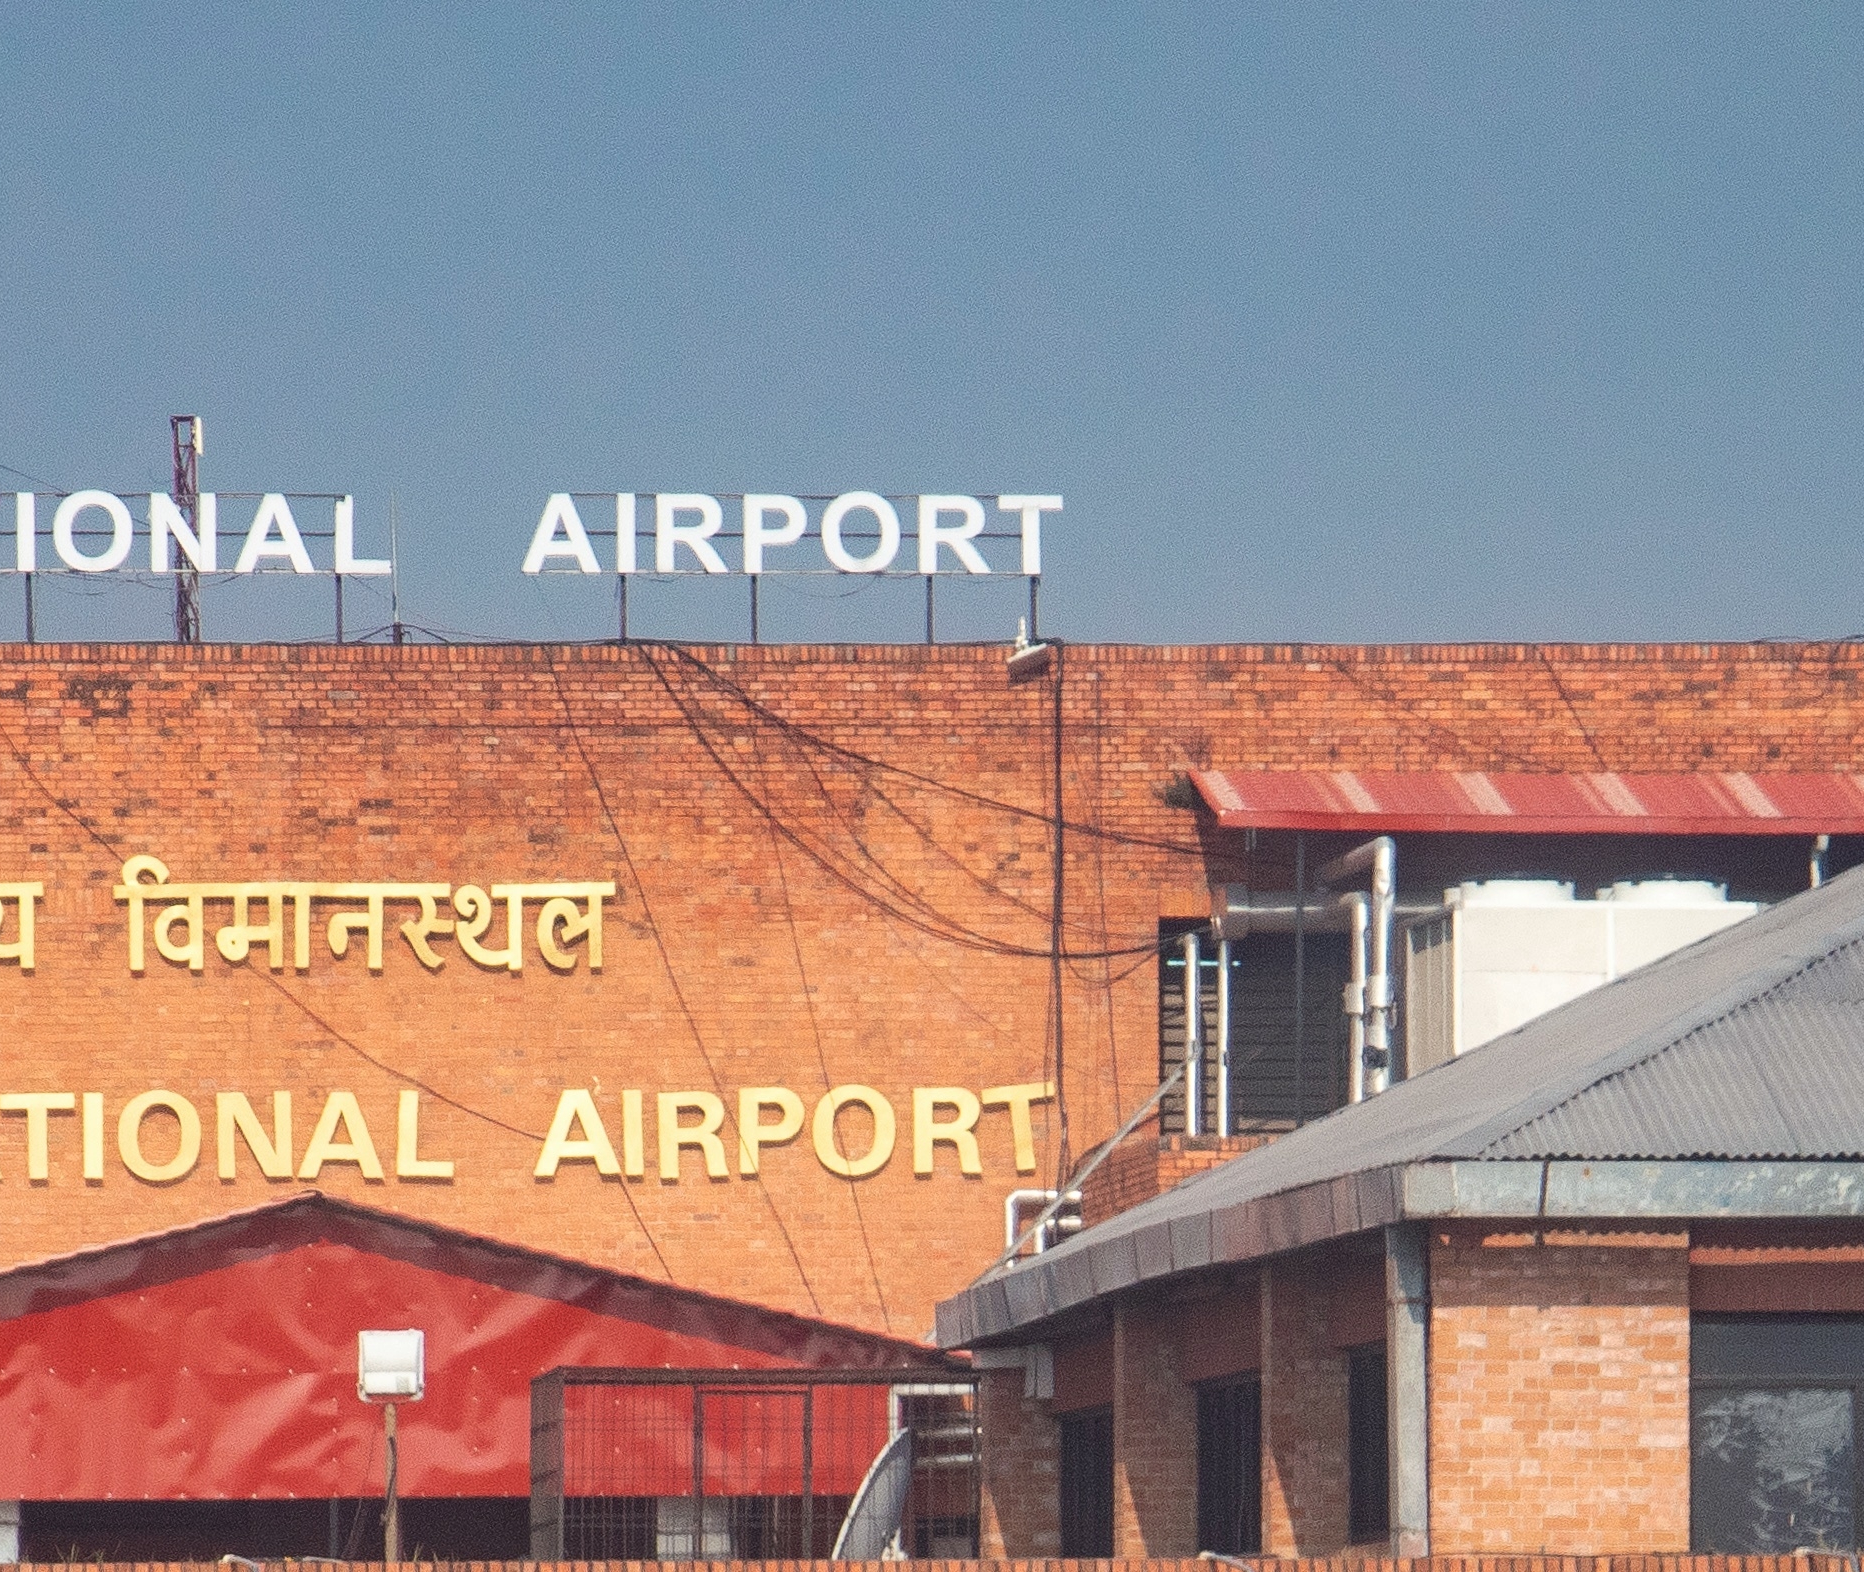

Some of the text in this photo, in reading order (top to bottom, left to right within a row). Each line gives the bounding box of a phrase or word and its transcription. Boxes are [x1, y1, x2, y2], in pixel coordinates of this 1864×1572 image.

[522, 490, 1064, 576] AIRPORT
[112, 853, 617, 973] विमानस्थल
[533, 1080, 1057, 1182] AIRPORT
